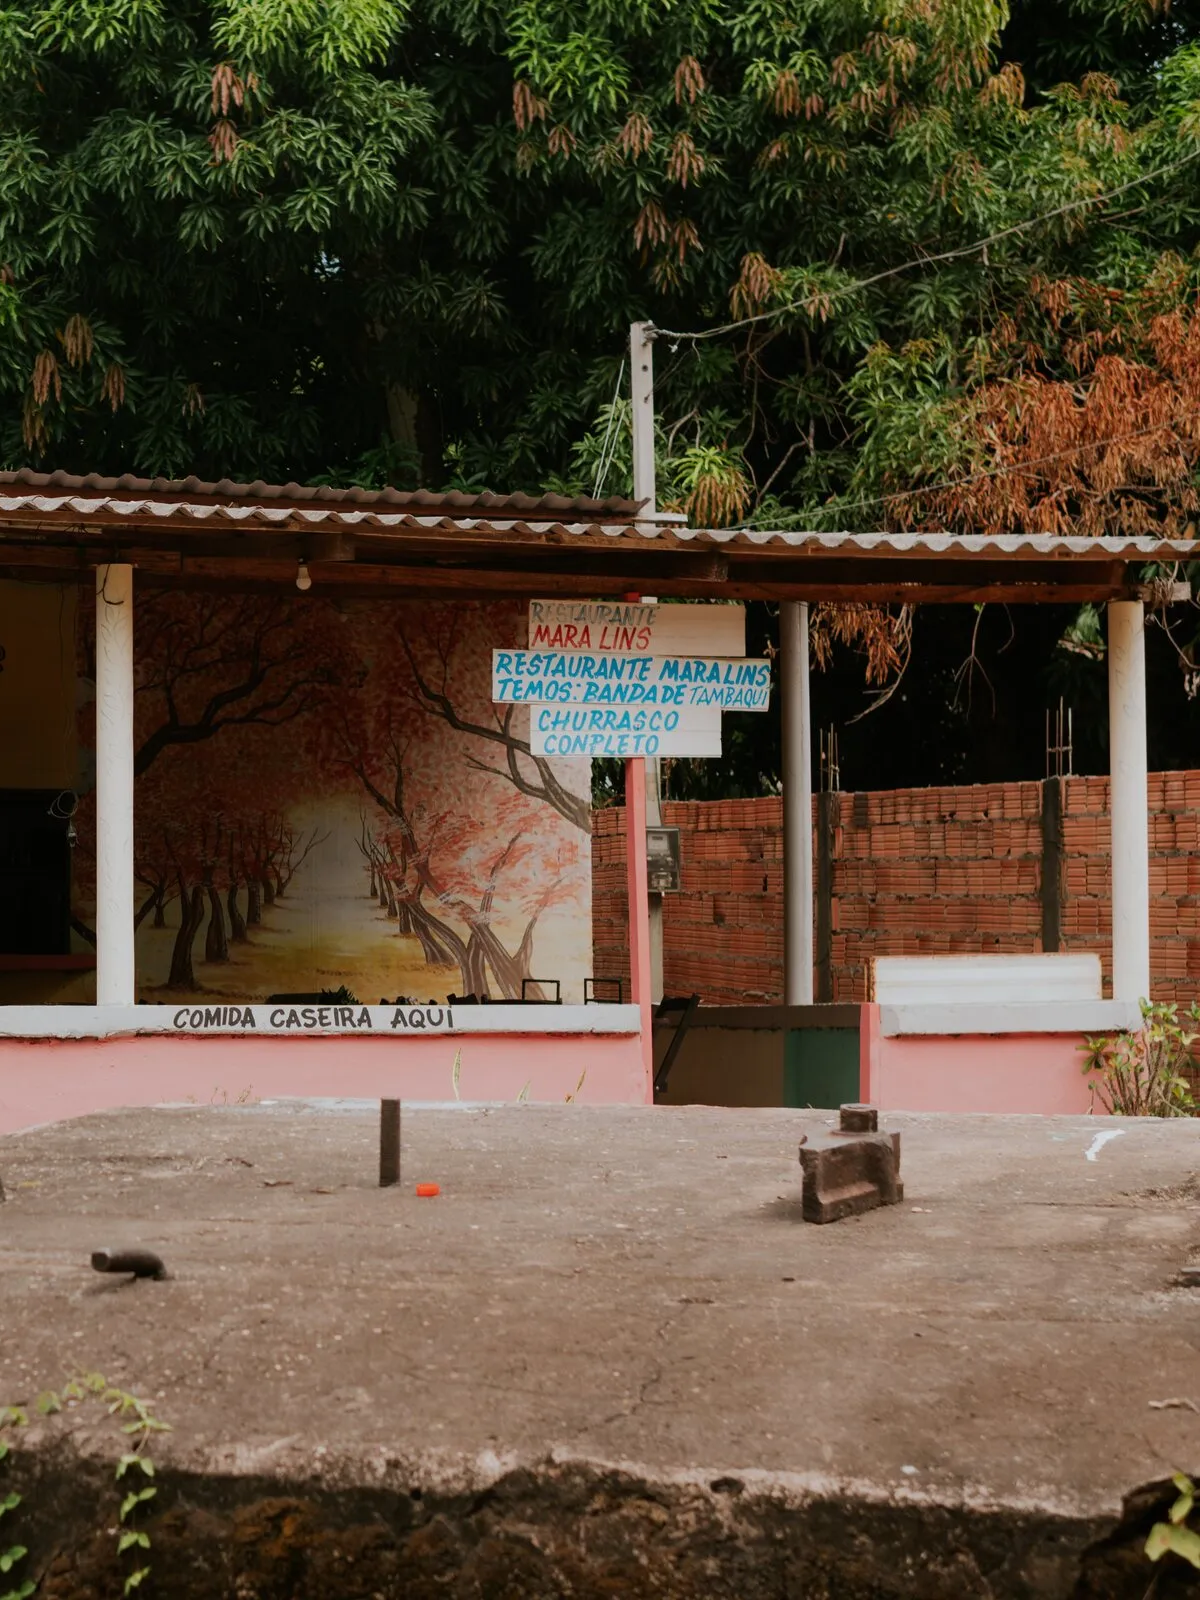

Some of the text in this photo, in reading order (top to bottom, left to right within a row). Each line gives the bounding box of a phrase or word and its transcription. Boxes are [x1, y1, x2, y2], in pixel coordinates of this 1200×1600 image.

[531, 601, 661, 626] RESTAURANTE
[531, 624, 652, 650] MARA LINS
[495, 653, 771, 687] RESTAURANTE MARA LINS
[689, 686, 768, 708] TAMBAQUI
[538, 709, 680, 731] CHURRASCO
[543, 734, 660, 756] CONPLETO
[173, 1007, 256, 1029] COMIDA
[270, 1006, 372, 1029] CASEIRA
